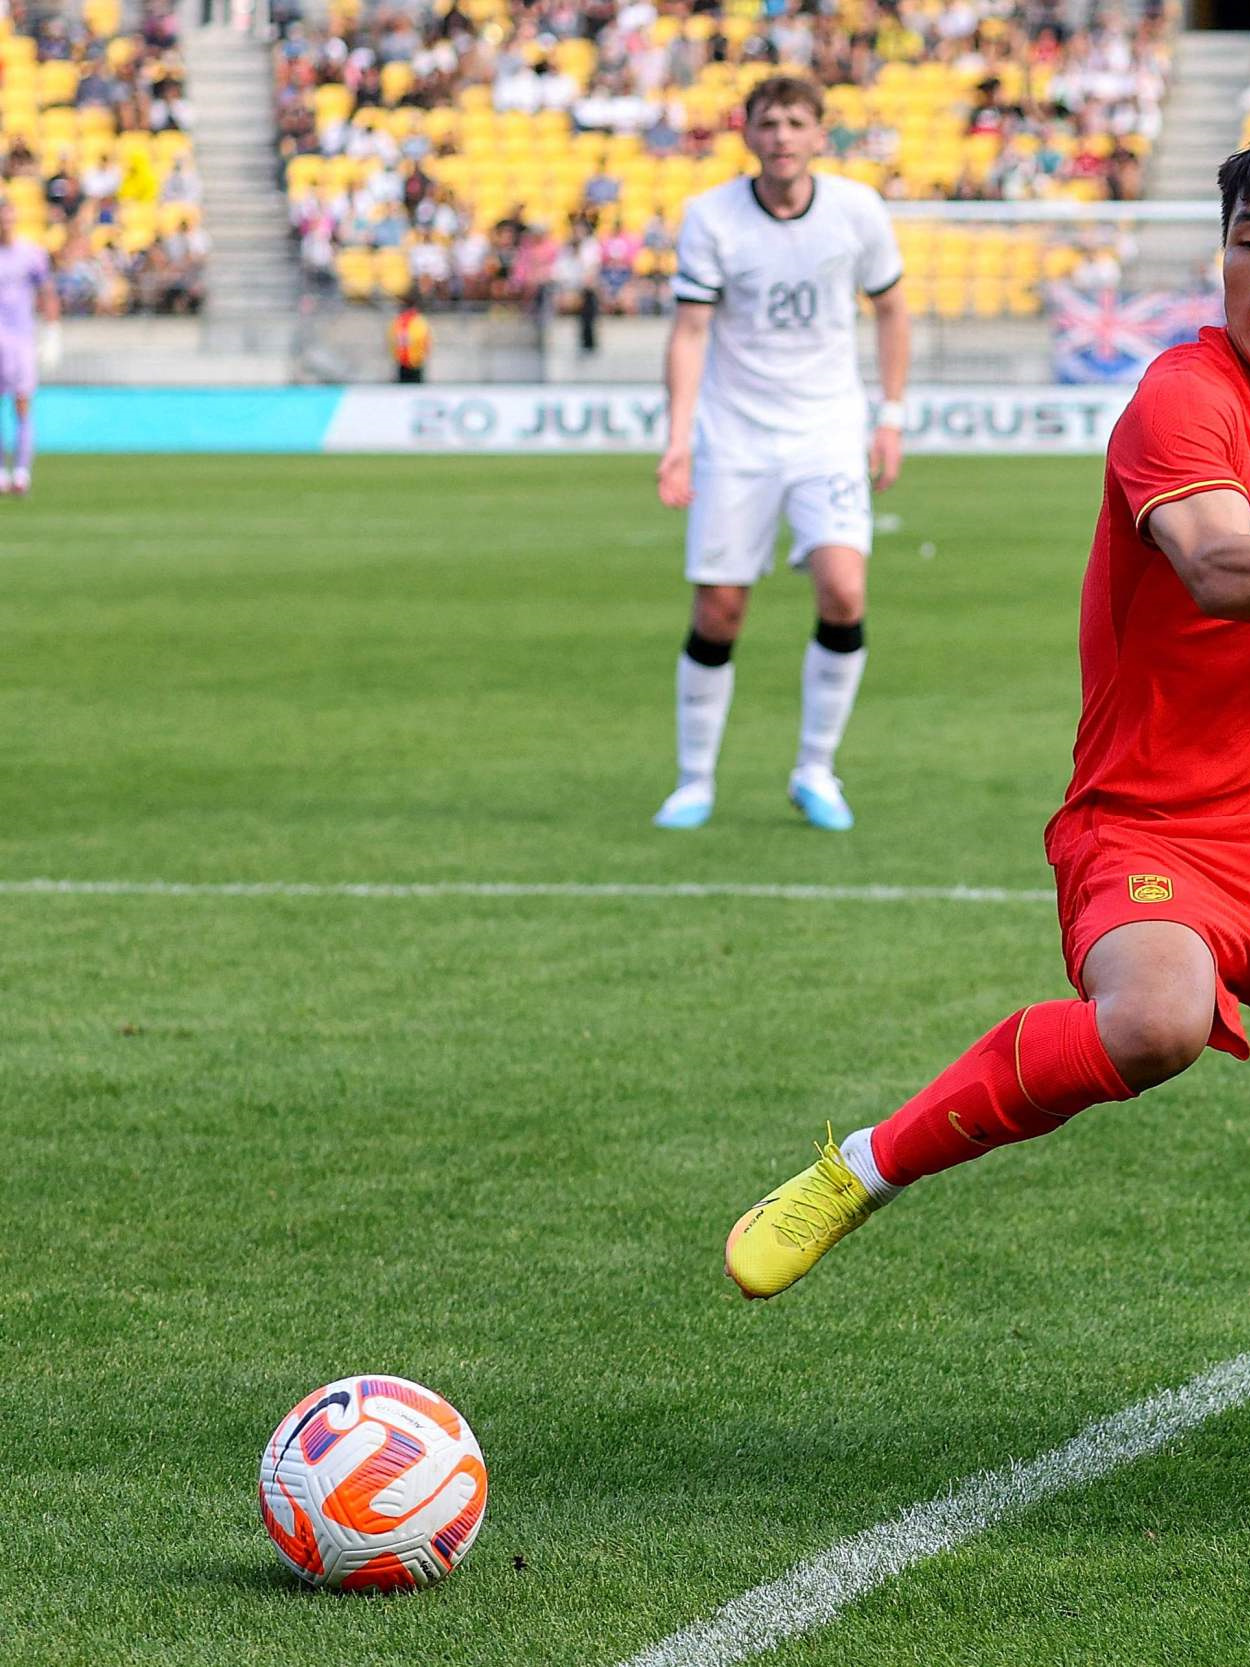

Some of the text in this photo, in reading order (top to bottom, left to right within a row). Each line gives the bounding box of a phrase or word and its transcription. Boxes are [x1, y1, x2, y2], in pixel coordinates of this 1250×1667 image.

[767, 280, 818, 329] 20
[410, 398, 667, 438] 20 JULY
